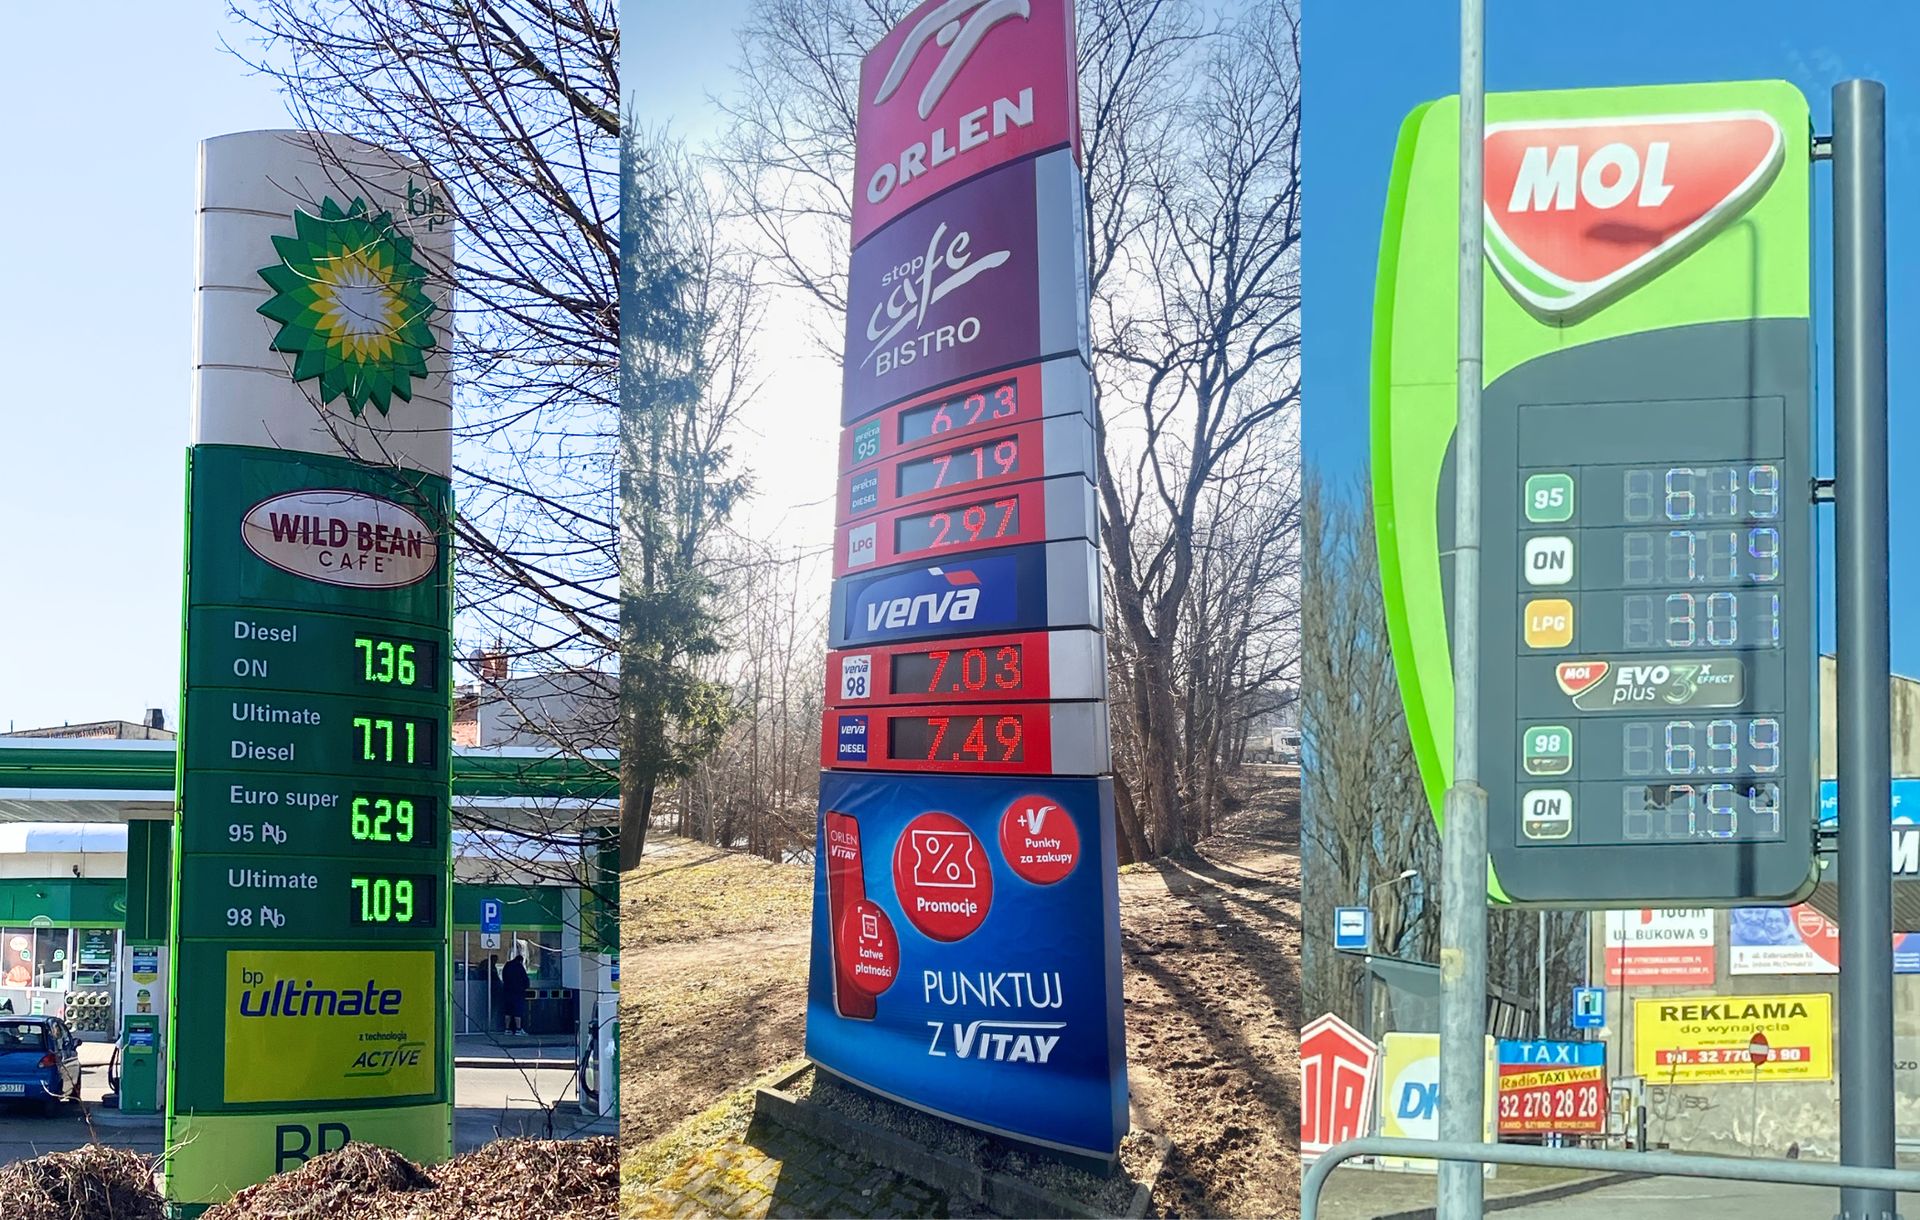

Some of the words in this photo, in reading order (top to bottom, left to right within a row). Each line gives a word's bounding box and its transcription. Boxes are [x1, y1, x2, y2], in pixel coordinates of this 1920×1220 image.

[866, 87, 1035, 204] ORLEN
[1507, 141, 1675, 213] MOL
[408, 173, 445, 231] bp
[881, 256, 925, 287] stop
[875, 317, 981, 377] BISTRO
[858, 438, 876, 460] 95
[852, 494, 876, 508] DIESEL
[1534, 487, 1564, 509] 95
[269, 512, 348, 548] WILD
[357, 522, 421, 559] BEAN
[852, 537, 873, 554] LPG
[319, 551, 384, 573] CAFE
[1533, 550, 1565, 570] ON
[867, 587, 981, 632] verva
[234, 621, 297, 642] Diesel
[1532, 615, 1565, 632] LPG
[234, 658, 268, 678] ON
[355, 638, 415, 685] 7.36
[844, 663, 868, 675] verva
[928, 646, 1021, 692] 7.03
[1616, 665, 1670, 686] EVO
[1696, 674, 1735, 684] EFFECT
[846, 676, 866, 697] 98
[1612, 684, 1656, 704] plus
[232, 702, 321, 725] Ultimate
[841, 724, 866, 735] verva
[928, 716, 1022, 761] 7.49
[231, 740, 294, 761] Diesel
[354, 718, 415, 763] 7.71
[840, 743, 866, 754] DIESEL
[1534, 734, 1561, 753] 98
[230, 785, 279, 805] Euro
[286, 793, 339, 811] super
[1533, 799, 1561, 816] ON
[352, 797, 414, 842] 6.29
[228, 824, 254, 843] 95
[830, 830, 857, 845] ORLEN
[1025, 838, 1061, 851] Punkty
[1020, 854, 1033, 864] za
[1036, 853, 1073, 865] zakupy
[228, 868, 318, 889] Ultimate
[351, 878, 413, 922] 7.09
[917, 897, 978, 917] Promocje
[227, 908, 252, 926] 98
[485, 902, 497, 923] P
[1636, 929, 1695, 940] BUKOWA
[1699, 928, 1708, 939] 9
[859, 946, 884, 961] Łatwe
[242, 967, 264, 985] bp
[855, 961, 892, 978] płatności
[240, 979, 402, 1017] ultimate
[923, 970, 1064, 1009] PUNKTUJ
[1660, 1003, 1808, 1021] REKLAMA
[927, 1021, 945, 1057] Z
[1680, 1024, 1700, 1034] do
[352, 1050, 421, 1068] ACTIVE
[1520, 1045, 1579, 1064] TAXI
[1698, 1051, 1718, 1062] 32
[1501, 1076, 1537, 1089] Radio
[1538, 1071, 1565, 1084] TAXI
[1567, 1068, 1598, 1081] West
[1501, 1095, 1519, 1118] 32
[1523, 1091, 1551, 1118] 278
[1555, 1088, 1575, 1118] 28
[1578, 1086, 1598, 1118] 28
